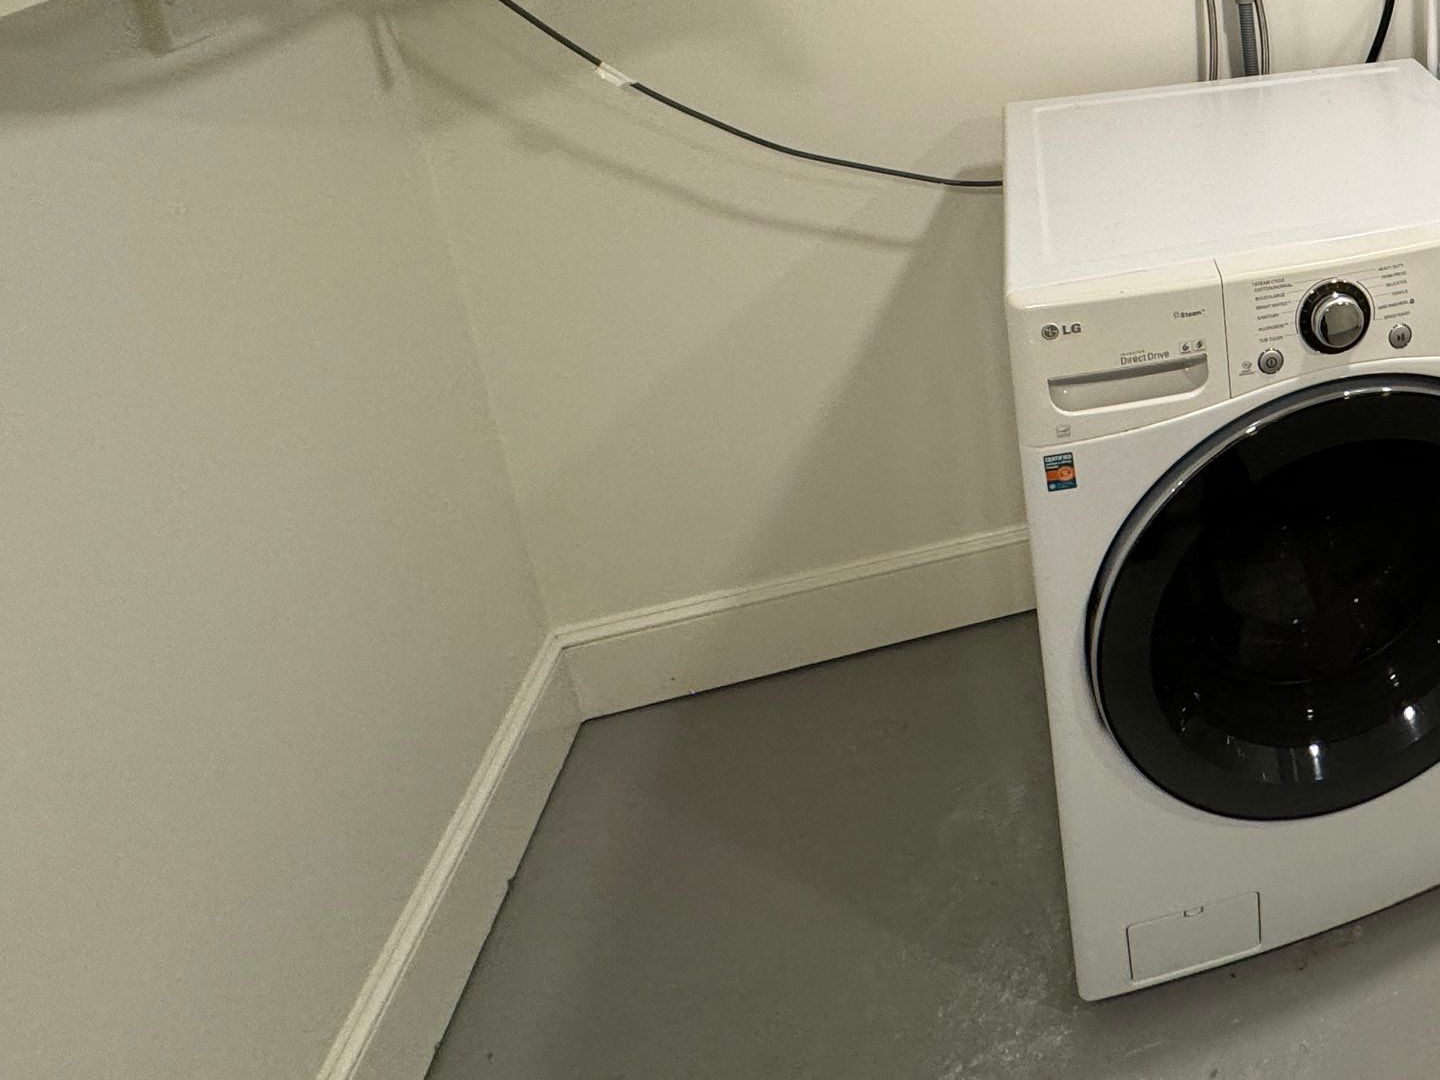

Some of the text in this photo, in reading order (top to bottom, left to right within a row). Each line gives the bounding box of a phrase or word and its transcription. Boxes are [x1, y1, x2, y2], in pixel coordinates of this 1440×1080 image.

[1062, 323, 1082, 336] LG
[1120, 354, 1147, 365] Direct
[1147, 350, 1170, 361] Drive
